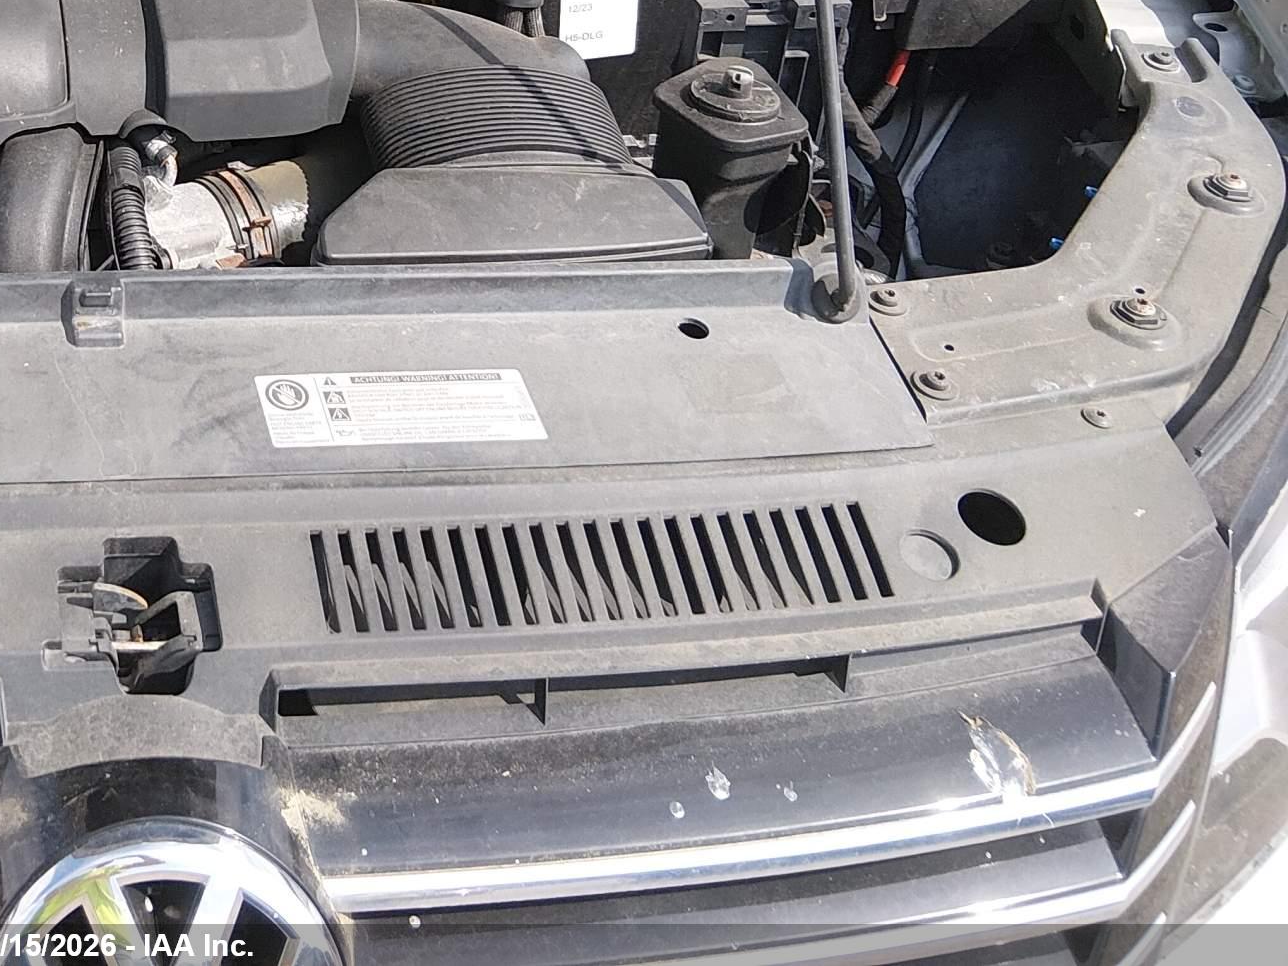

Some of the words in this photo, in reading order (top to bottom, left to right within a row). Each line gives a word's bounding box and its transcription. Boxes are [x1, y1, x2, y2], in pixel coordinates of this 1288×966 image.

[568, 3, 593, 14] 12/23
[565, 31, 604, 42] H5-DLG
[402, 375, 447, 383] WARNING!
[448, 373, 499, 381] ATTENTION!
